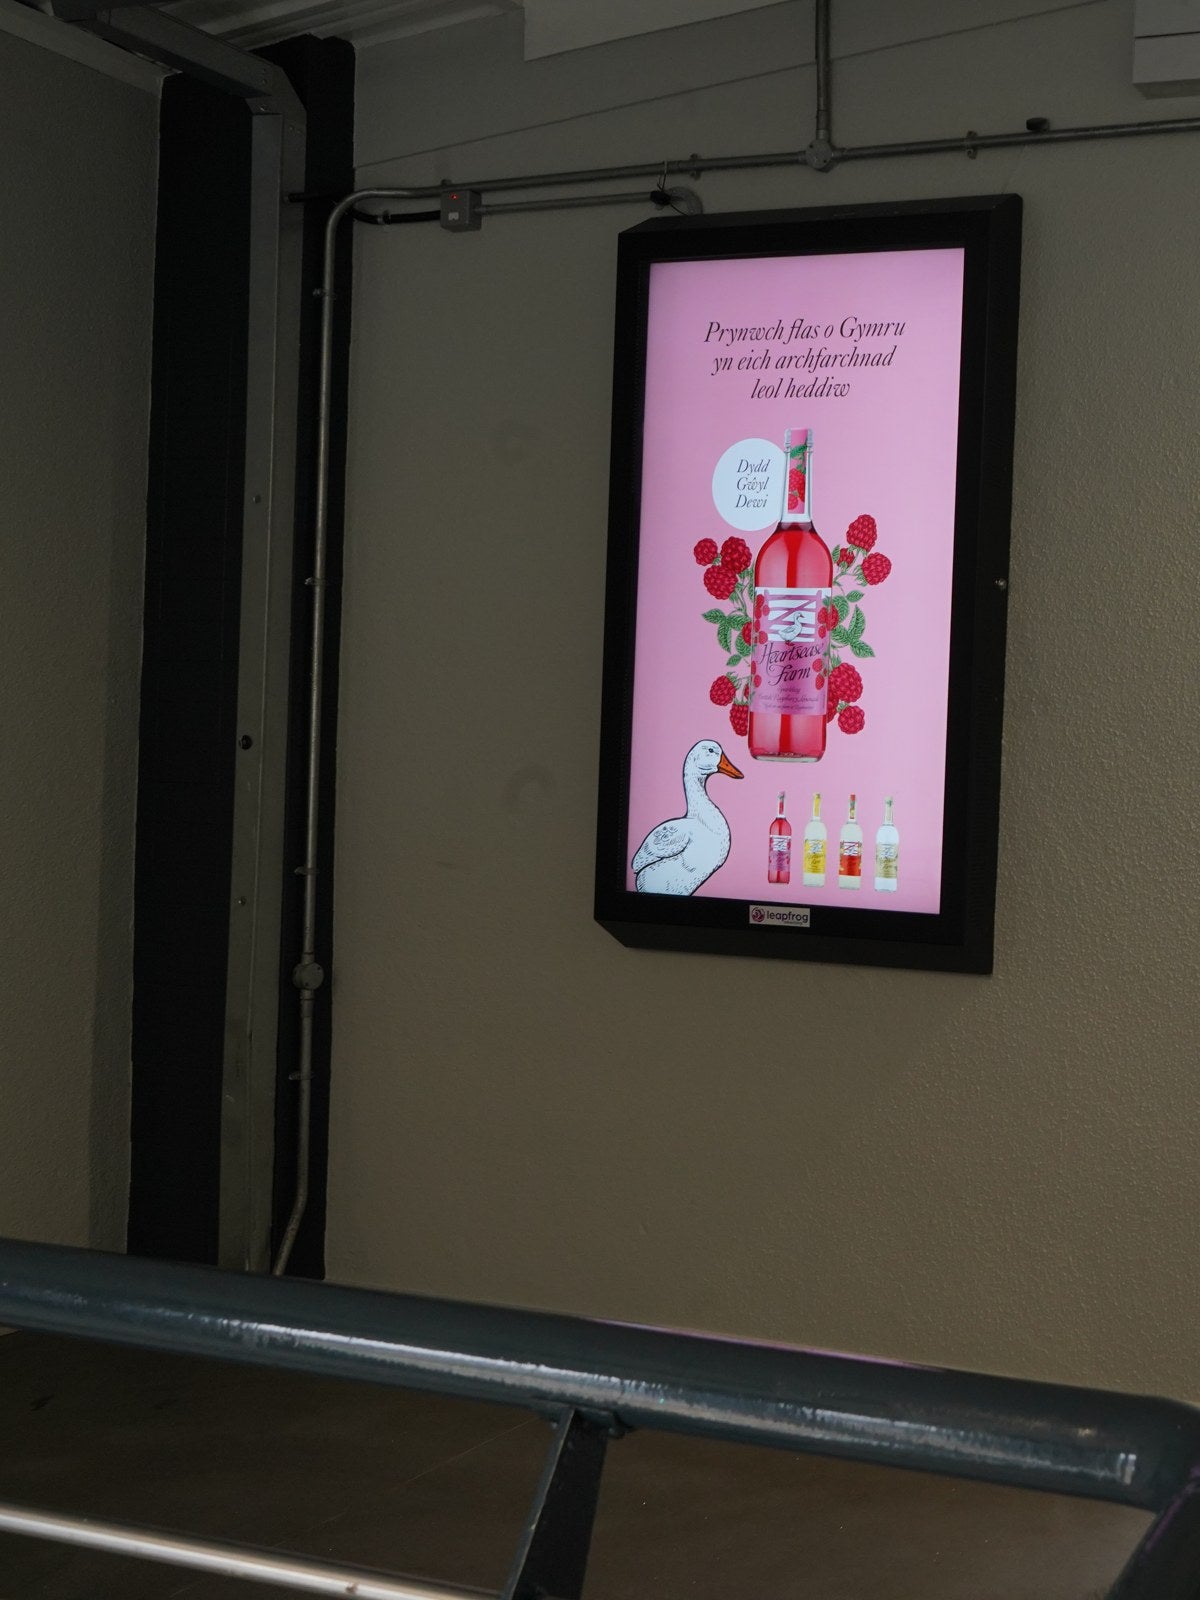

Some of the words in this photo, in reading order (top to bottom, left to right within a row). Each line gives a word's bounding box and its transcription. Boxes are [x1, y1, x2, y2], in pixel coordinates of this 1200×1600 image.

[704, 320, 784, 346] Prynwch
[783, 318, 820, 344] flas
[824, 326, 834, 338] o
[840, 316, 906, 342] Gymru
[711, 356, 734, 375] yn
[737, 349, 771, 370] eich
[775, 345, 898, 373] archfarchnad
[751, 378, 783, 399] leol
[784, 376, 851, 398] heddiw
[736, 460, 768, 474] Dydd
[735, 494, 768, 508] Dewi
[766, 910, 808, 923] leapfrog
